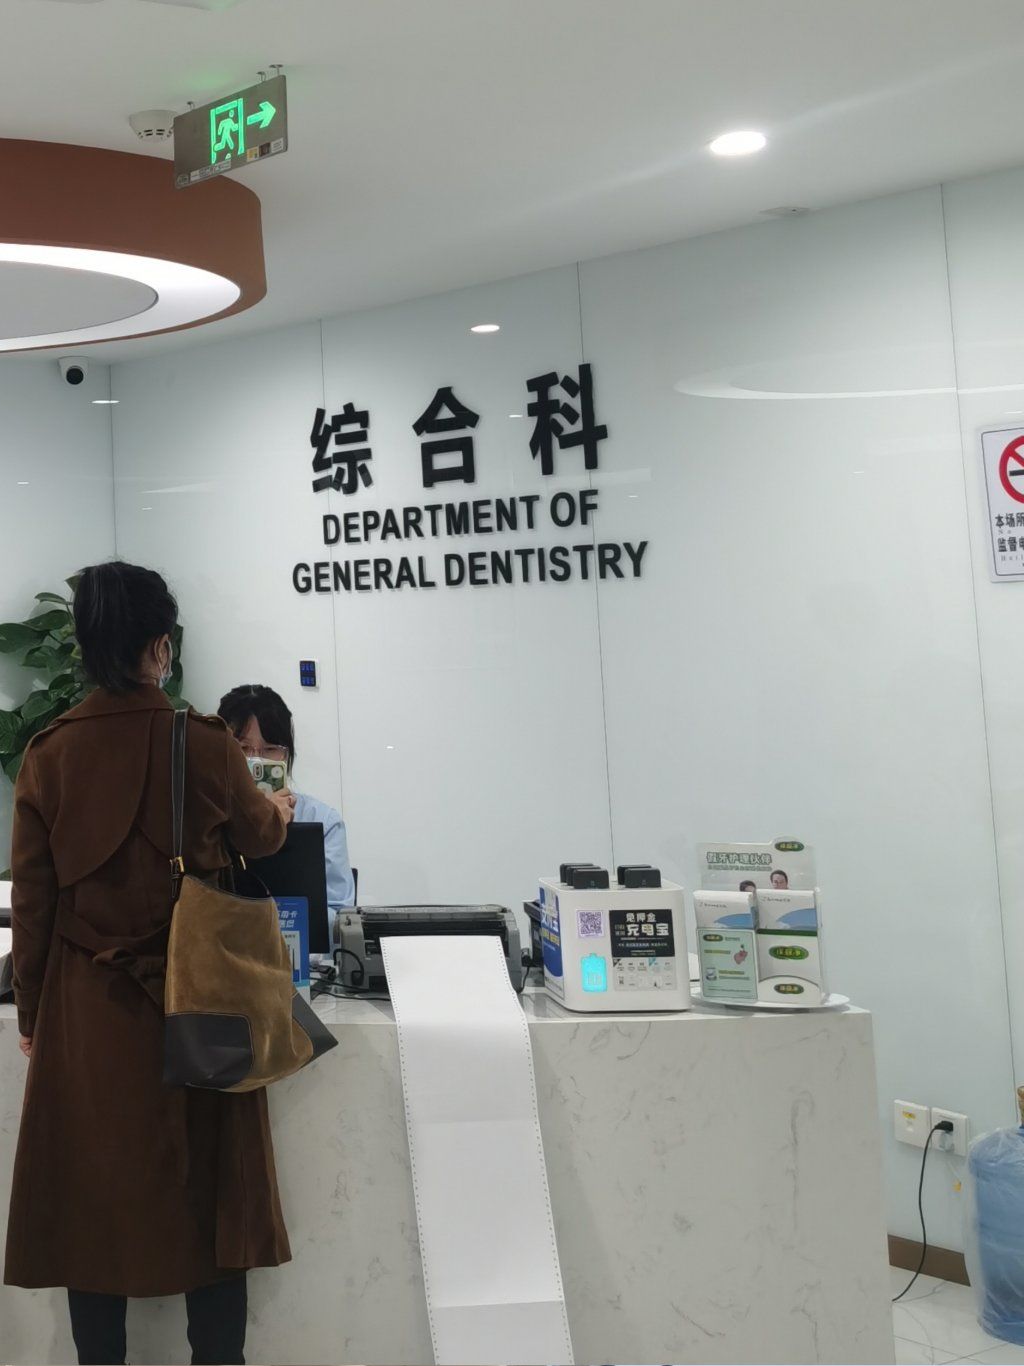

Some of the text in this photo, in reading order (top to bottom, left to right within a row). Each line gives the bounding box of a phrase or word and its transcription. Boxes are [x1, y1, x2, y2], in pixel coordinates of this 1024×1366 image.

[310, 363, 608, 494] 综合科
[322, 488, 599, 545] DEPARTMENT OF
[292, 540, 649, 594] GENERAL DENTISTRY
[706, 851, 772, 865] 假牙护理伙伴
[626, 923, 669, 936] 充电宝
